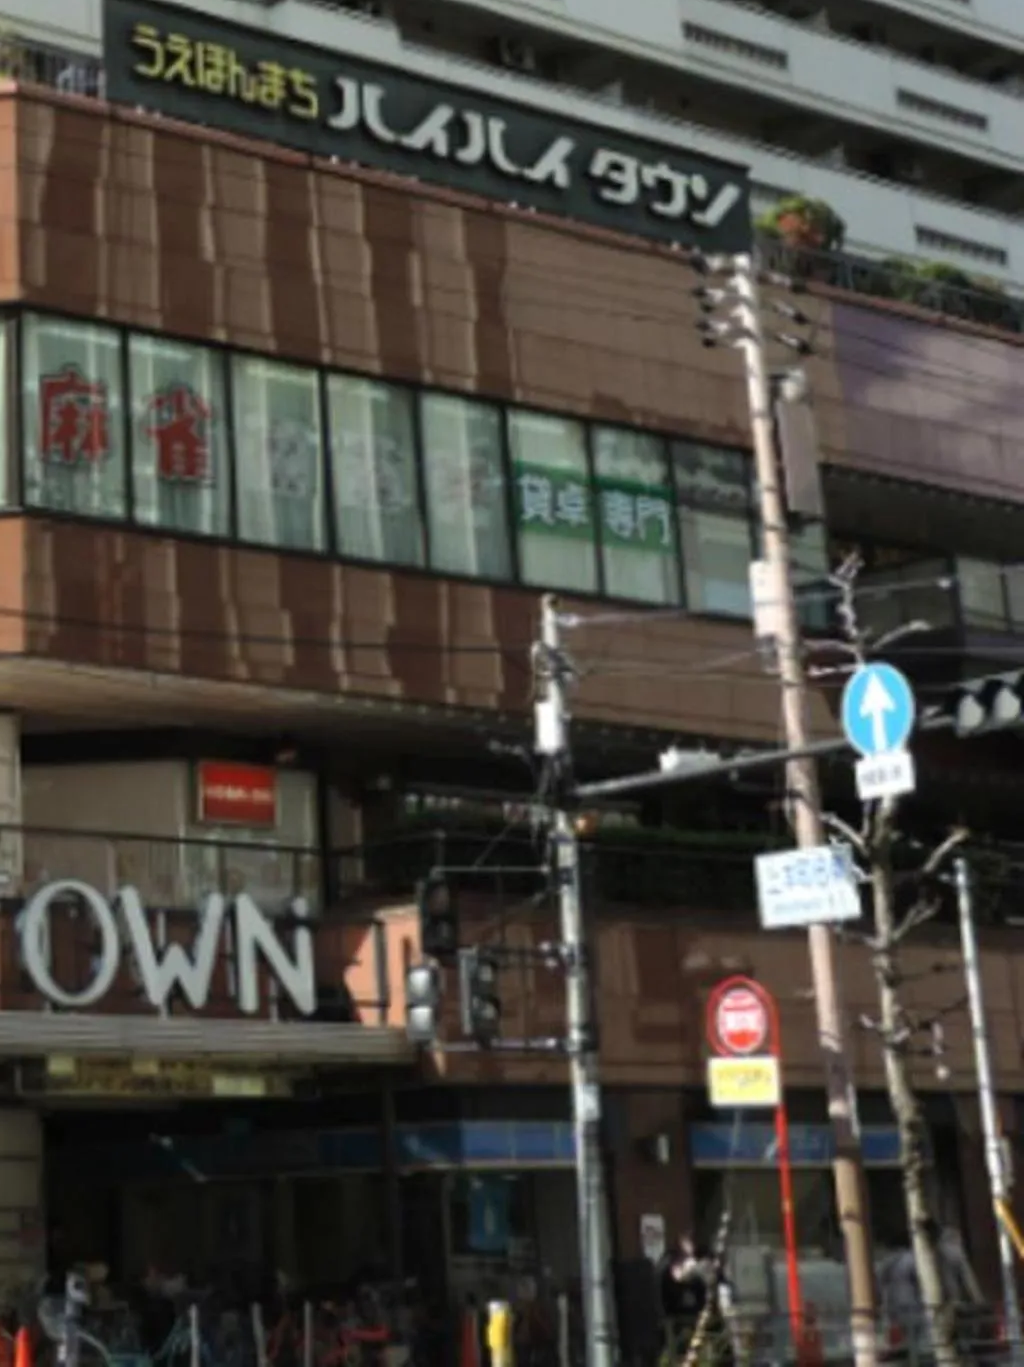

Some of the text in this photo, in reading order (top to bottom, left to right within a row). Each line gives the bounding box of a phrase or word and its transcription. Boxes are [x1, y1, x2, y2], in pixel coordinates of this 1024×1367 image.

[132, 22, 318, 120] うえほんまち
[39, 363, 214, 486] 麻雀
